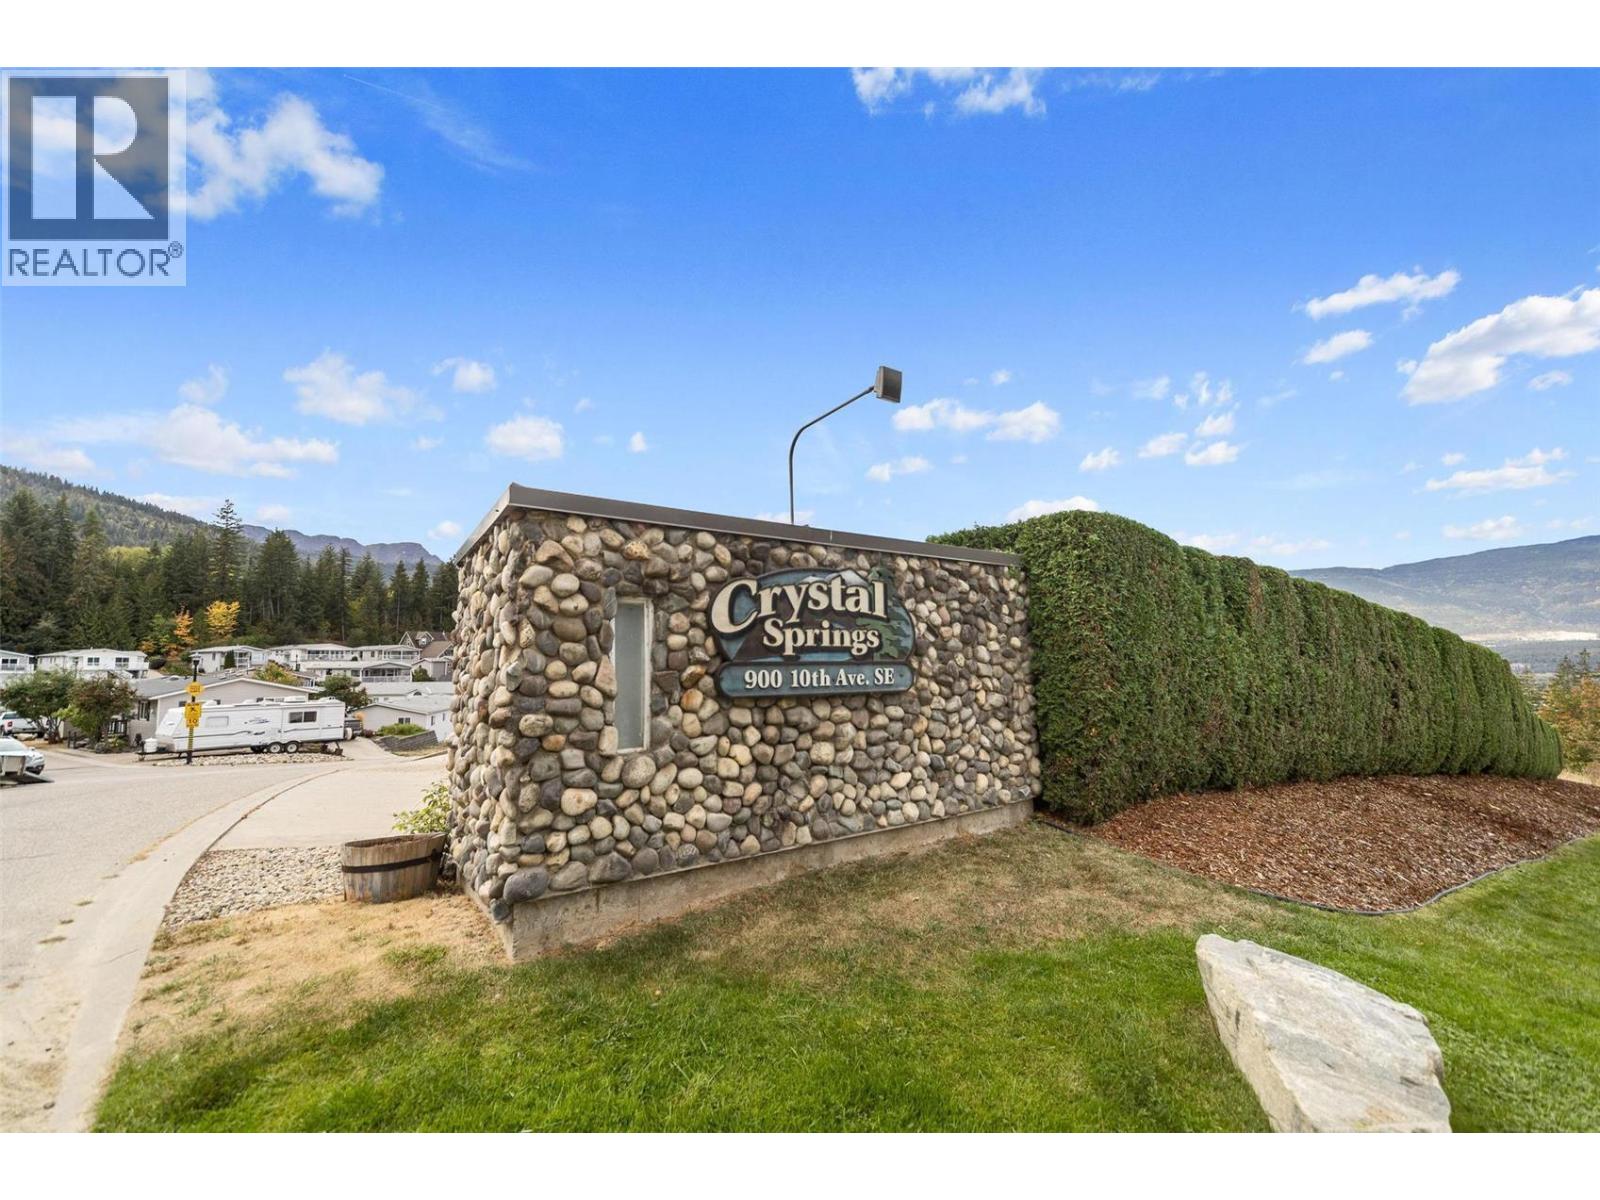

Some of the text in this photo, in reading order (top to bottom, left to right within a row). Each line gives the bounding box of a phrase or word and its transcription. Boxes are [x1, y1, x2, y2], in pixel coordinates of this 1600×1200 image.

[711, 575, 888, 634] Crystal
[762, 618, 880, 656] Springs
[744, 667, 895, 689] 900 10th Ave. SE
